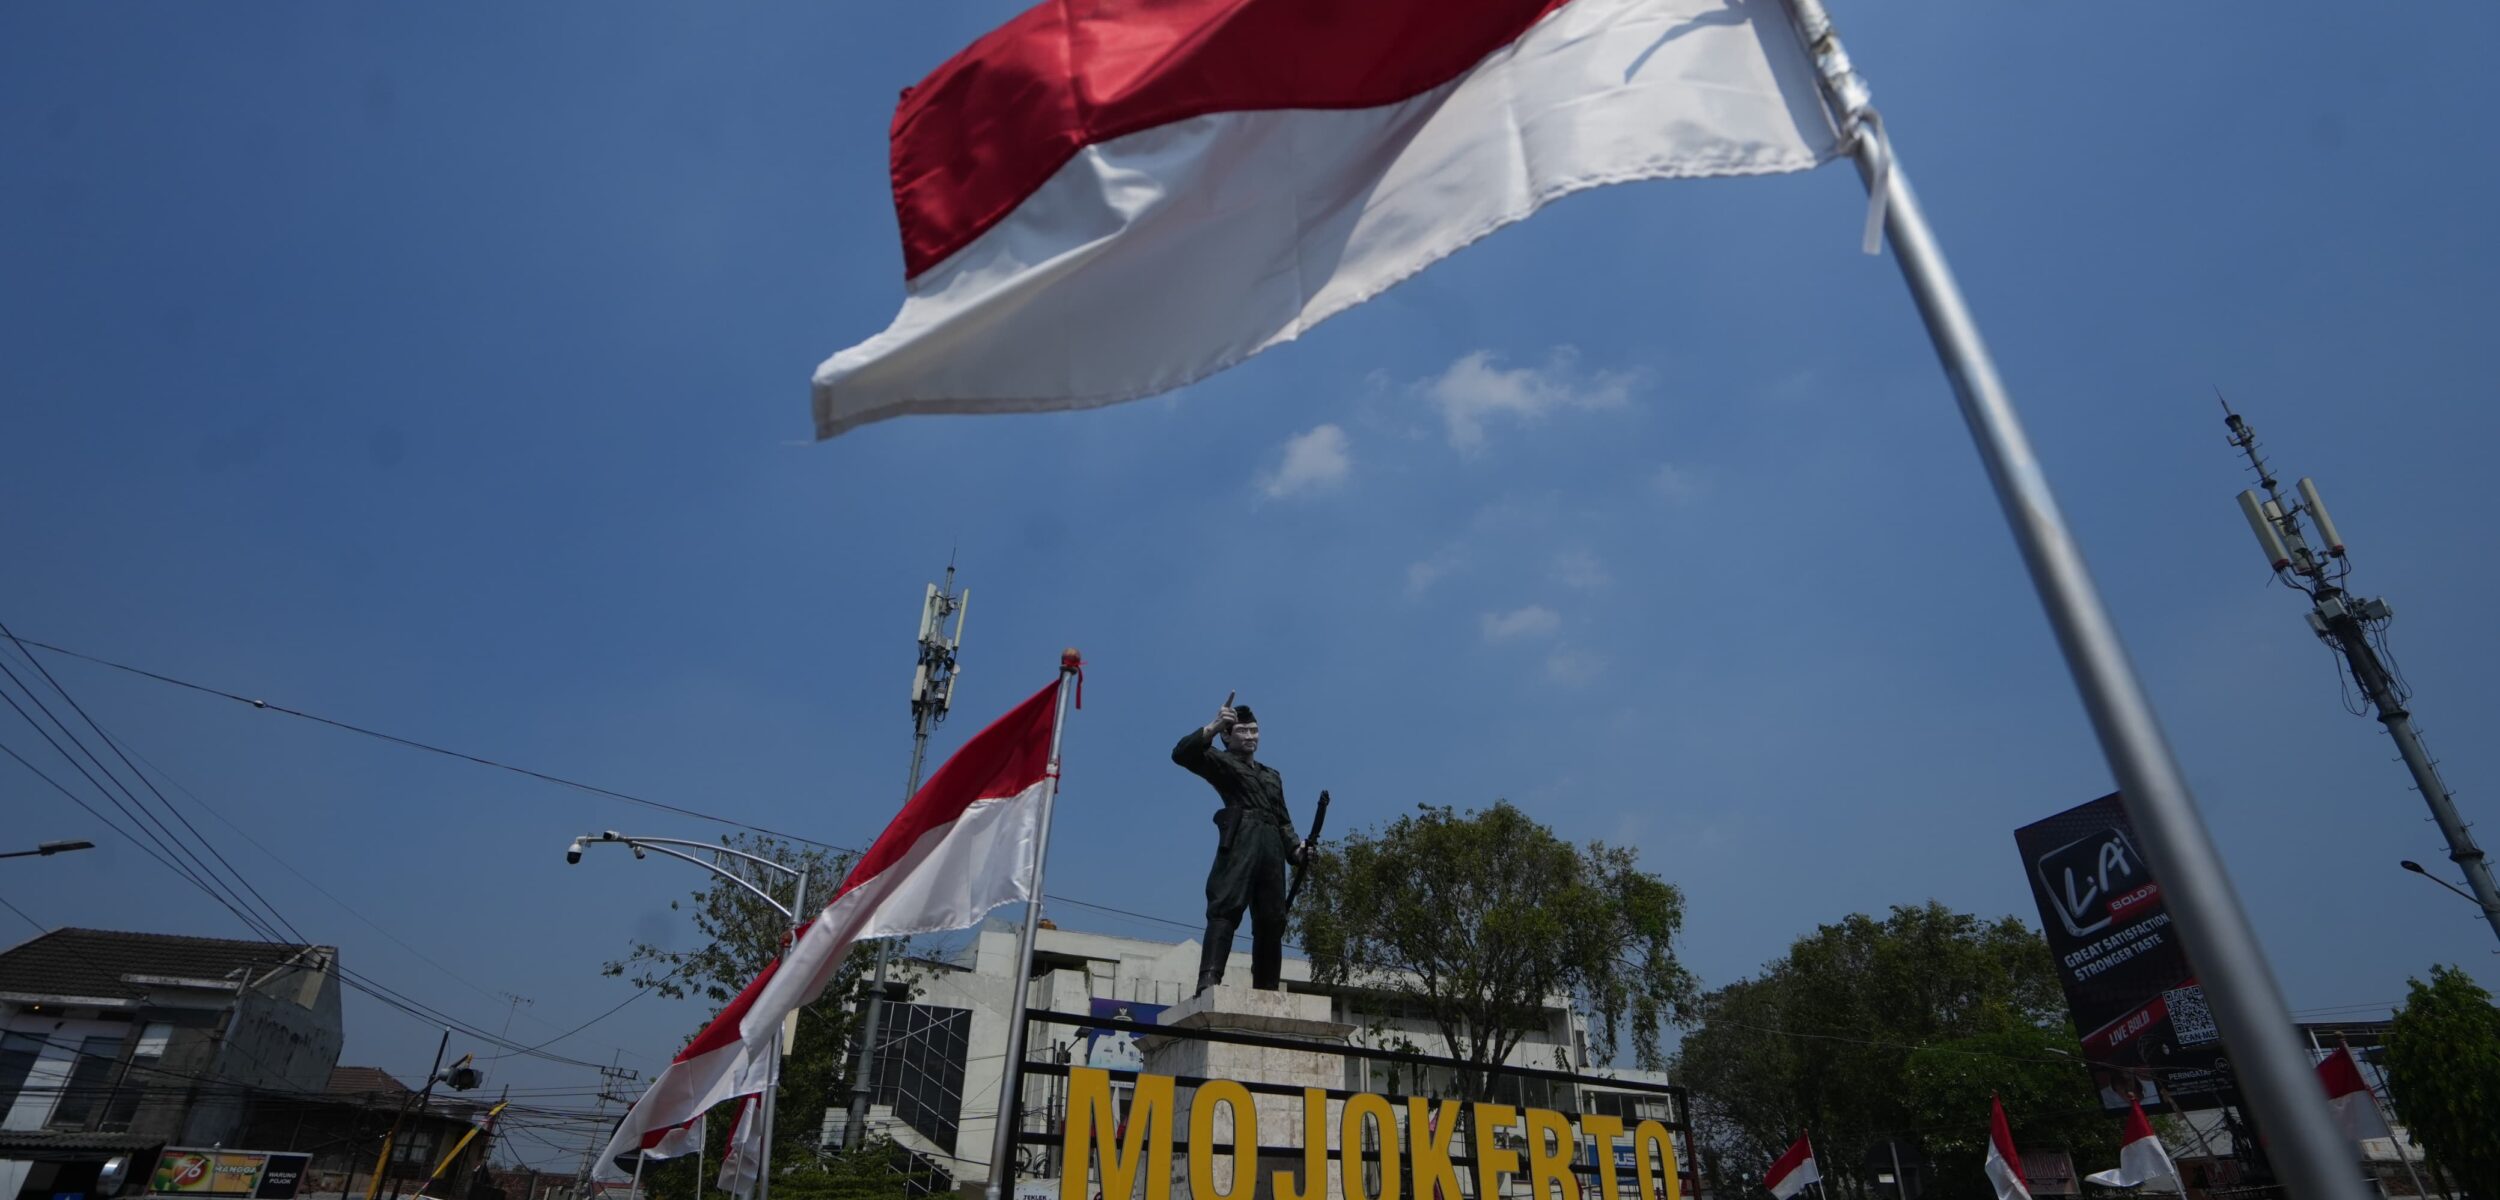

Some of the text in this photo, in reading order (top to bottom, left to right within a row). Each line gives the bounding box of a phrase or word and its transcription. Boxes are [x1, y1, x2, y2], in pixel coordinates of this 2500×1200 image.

[2111, 889, 2147, 910] BOLD
[2064, 912, 2170, 968] GREAT SATISFACTION
[2074, 932, 2164, 982] STRONGER TASTE
[2108, 1009, 2150, 1046] LIVE BOLD
[2178, 1032, 2201, 1043] SCAN
[174, 1159, 205, 1183] 76
[268, 1171, 297, 1179] WARUNG
